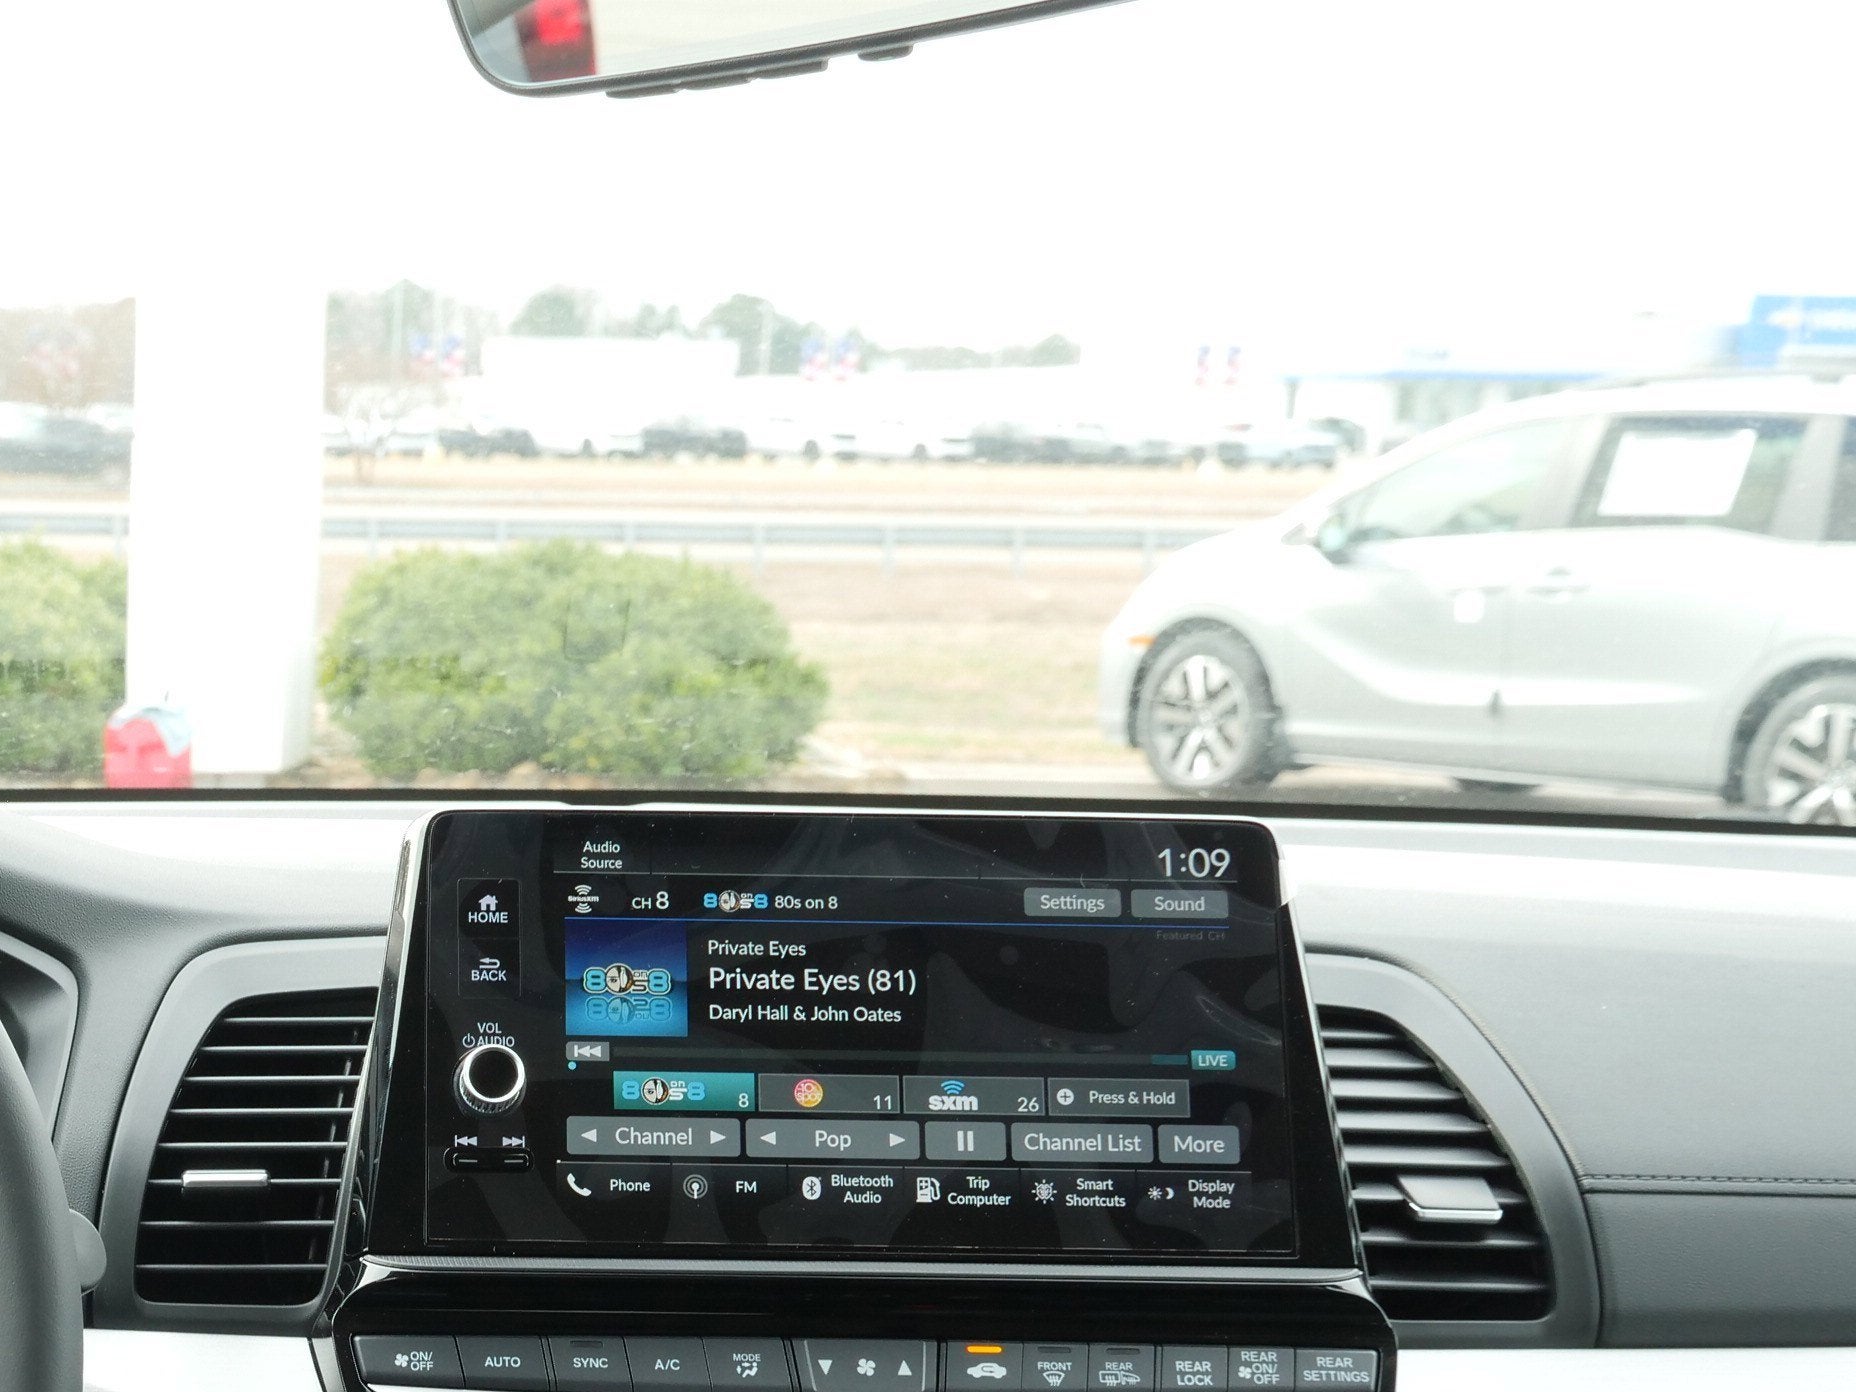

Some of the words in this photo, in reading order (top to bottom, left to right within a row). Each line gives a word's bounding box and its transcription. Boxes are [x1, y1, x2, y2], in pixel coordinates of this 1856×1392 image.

[583, 840, 621, 854] Audio
[580, 857, 623, 869] Source
[1157, 847, 1231, 878] 1:09
[631, 898, 652, 910] CH
[655, 891, 670, 910] 8
[774, 896, 802, 910] 80s
[805, 898, 825, 910] on
[828, 896, 839, 910] 8
[1040, 894, 1106, 913] Settings
[1154, 896, 1206, 912] Sound
[468, 911, 509, 924] HOME
[708, 939, 764, 956] Private
[769, 940, 807, 960] Eyes
[471, 970, 507, 982] BACK
[709, 967, 795, 991] Private
[803, 968, 861, 996] Eyes
[867, 968, 917, 996] (81)
[708, 1004, 753, 1023] Daryl
[757, 1005, 789, 1021] Hall
[793, 1006, 807, 1022] &
[810, 1006, 849, 1022] John
[853, 1007, 902, 1022] Oates
[477, 1022, 502, 1034] VOL
[477, 1035, 515, 1048] AUDIO
[1197, 1055, 1228, 1068] LIVE
[738, 1093, 749, 1109] 8
[873, 1095, 892, 1110] 11
[1089, 1090, 1125, 1105] Press
[1128, 1091, 1140, 1105] &
[1142, 1091, 1176, 1105] Hold
[1017, 1097, 1040, 1112] 26
[615, 1127, 693, 1146] Channel
[815, 1130, 852, 1151] Pop
[1024, 1133, 1102, 1151] Channel
[1107, 1134, 1142, 1152] List
[1173, 1135, 1226, 1153] More
[609, 1178, 651, 1192] Phone
[735, 1181, 758, 1193] FM
[831, 1174, 894, 1188] Bluetooth
[966, 1176, 990, 1192] Trip
[1076, 1178, 1114, 1191] Smart
[1188, 1179, 1235, 1195] Display
[843, 1191, 882, 1204] Audio
[947, 1193, 1012, 1208] Computer
[1065, 1194, 1126, 1207] Shortcuts
[1192, 1196, 1232, 1209] Mode
[410, 1351, 434, 1362] ON/
[484, 1356, 521, 1368] AUTO
[573, 1357, 609, 1369] SYNC
[732, 1353, 762, 1363] MODE
[1241, 1351, 1278, 1363] REAR
[1316, 1356, 1354, 1369] REAR
[410, 1361, 434, 1372] OFF
[654, 1358, 681, 1371] A/C
[1037, 1361, 1073, 1372] FRONT
[1105, 1361, 1134, 1372] REAR
[1175, 1360, 1212, 1372] REAR
[1252, 1363, 1278, 1374] ON/
[1177, 1374, 1214, 1386] LOCK
[1253, 1374, 1280, 1385] OFF
[1303, 1370, 1370, 1383] SETTINGS
